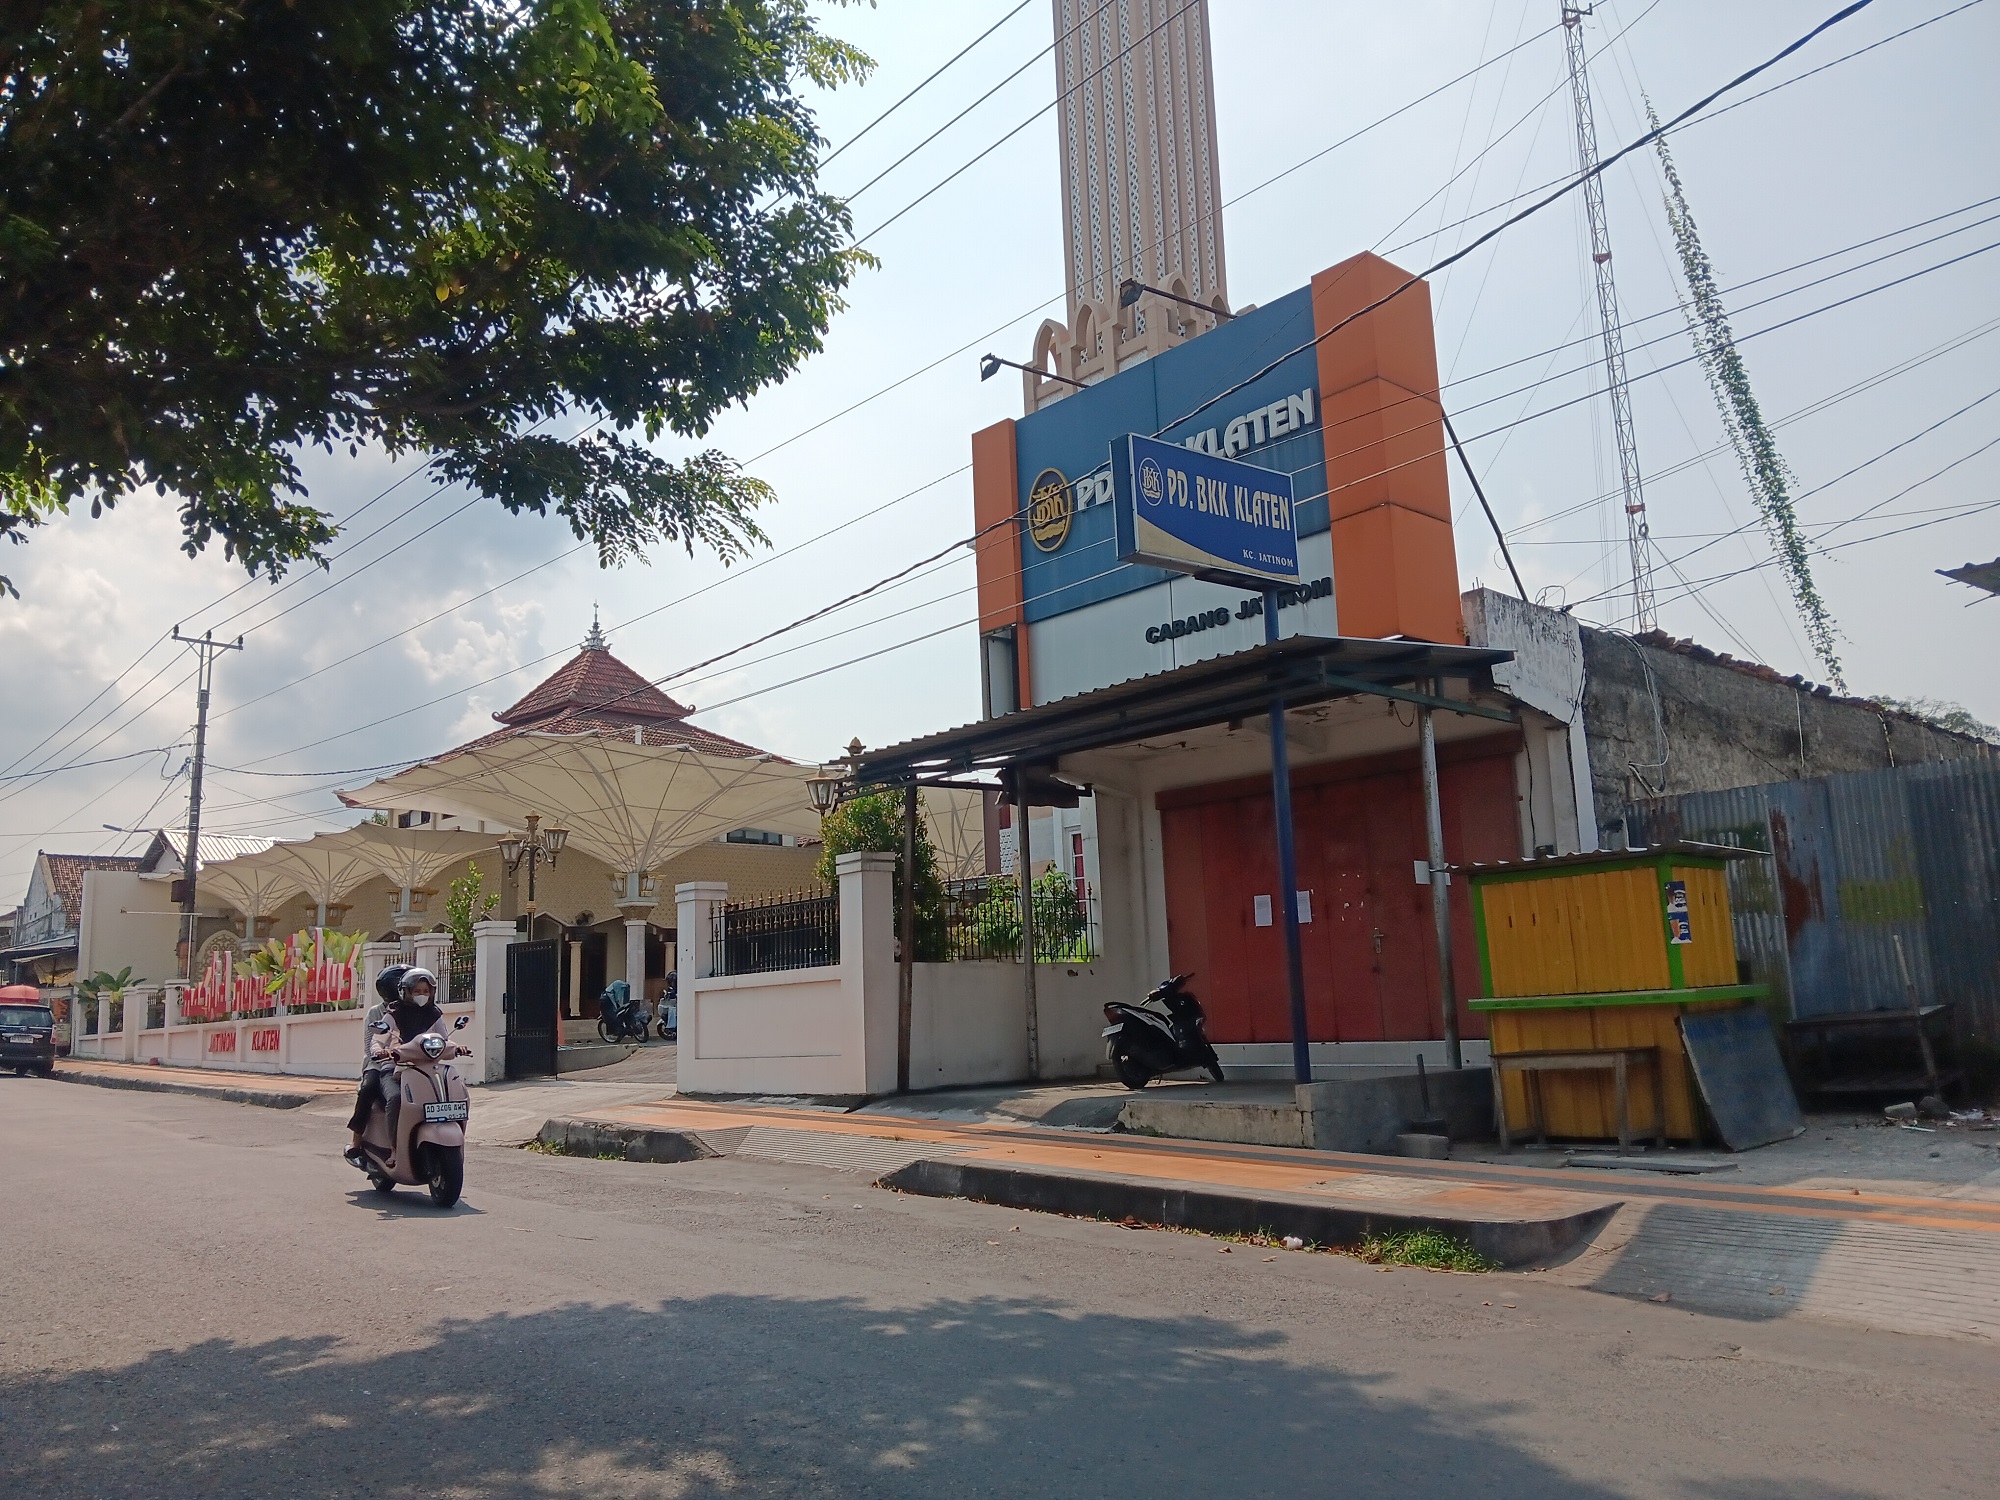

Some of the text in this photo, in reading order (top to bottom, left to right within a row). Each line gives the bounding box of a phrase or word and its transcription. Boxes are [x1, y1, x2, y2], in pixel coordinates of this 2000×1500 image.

[1167, 468, 1291, 531] PD. BKK KLATEN
[1242, 549, 1294, 568] KC. JATINOM
[1145, 576, 1332, 645] CABANG JANOM
[208, 1029, 280, 1053] JATINOM KLATEN
[427, 1105, 435, 1113] AD
